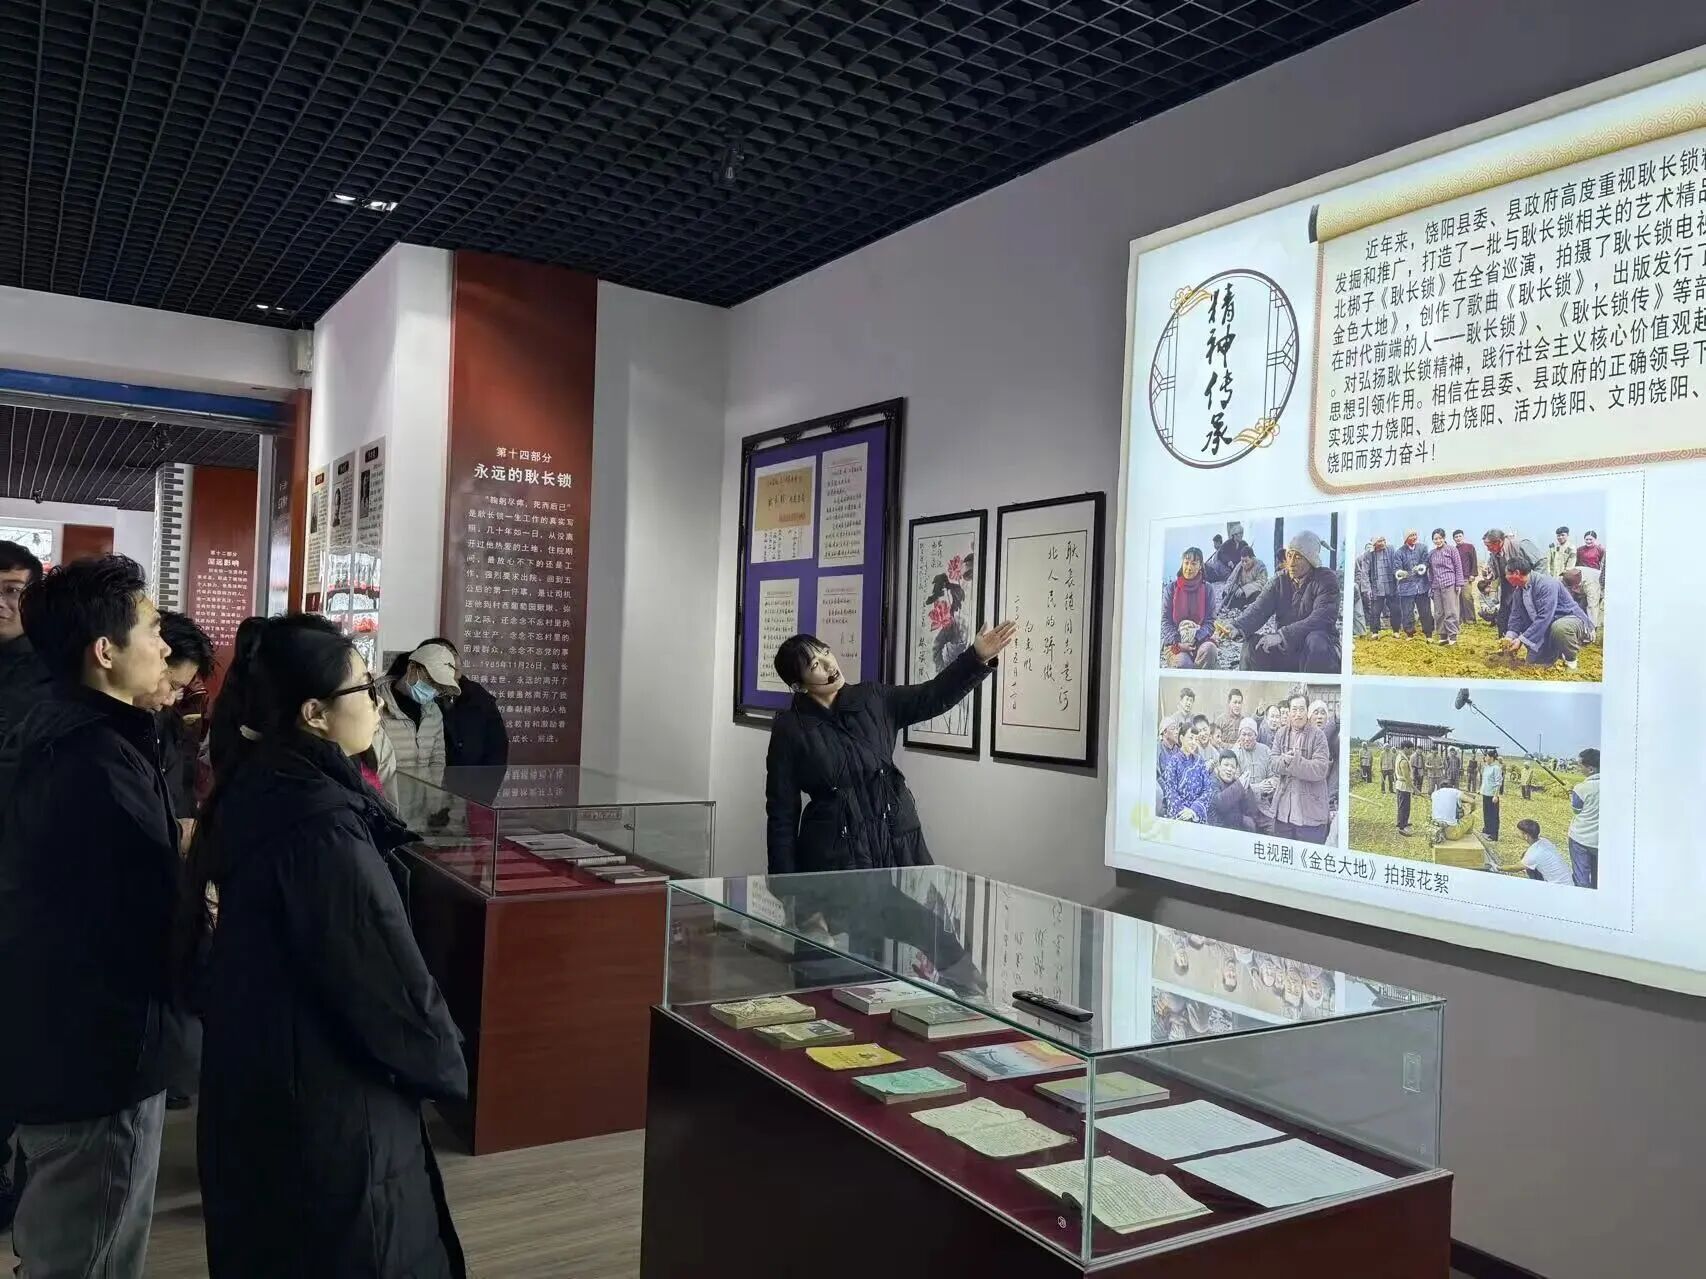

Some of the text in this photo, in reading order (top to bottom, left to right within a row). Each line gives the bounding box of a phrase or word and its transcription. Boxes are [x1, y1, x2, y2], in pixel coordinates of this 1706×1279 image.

[1365, 146, 1706, 261] 近年来，饶阳县委、县政府高度重视耿长锁
[1201, 282, 1236, 456] 精神传承
[474, 463, 572, 488] 永远的耿长锁
[496, 447, 552, 463] 第十四部分
[1253, 840, 1450, 895] 电视剧《金色大地》拍摄花絮
